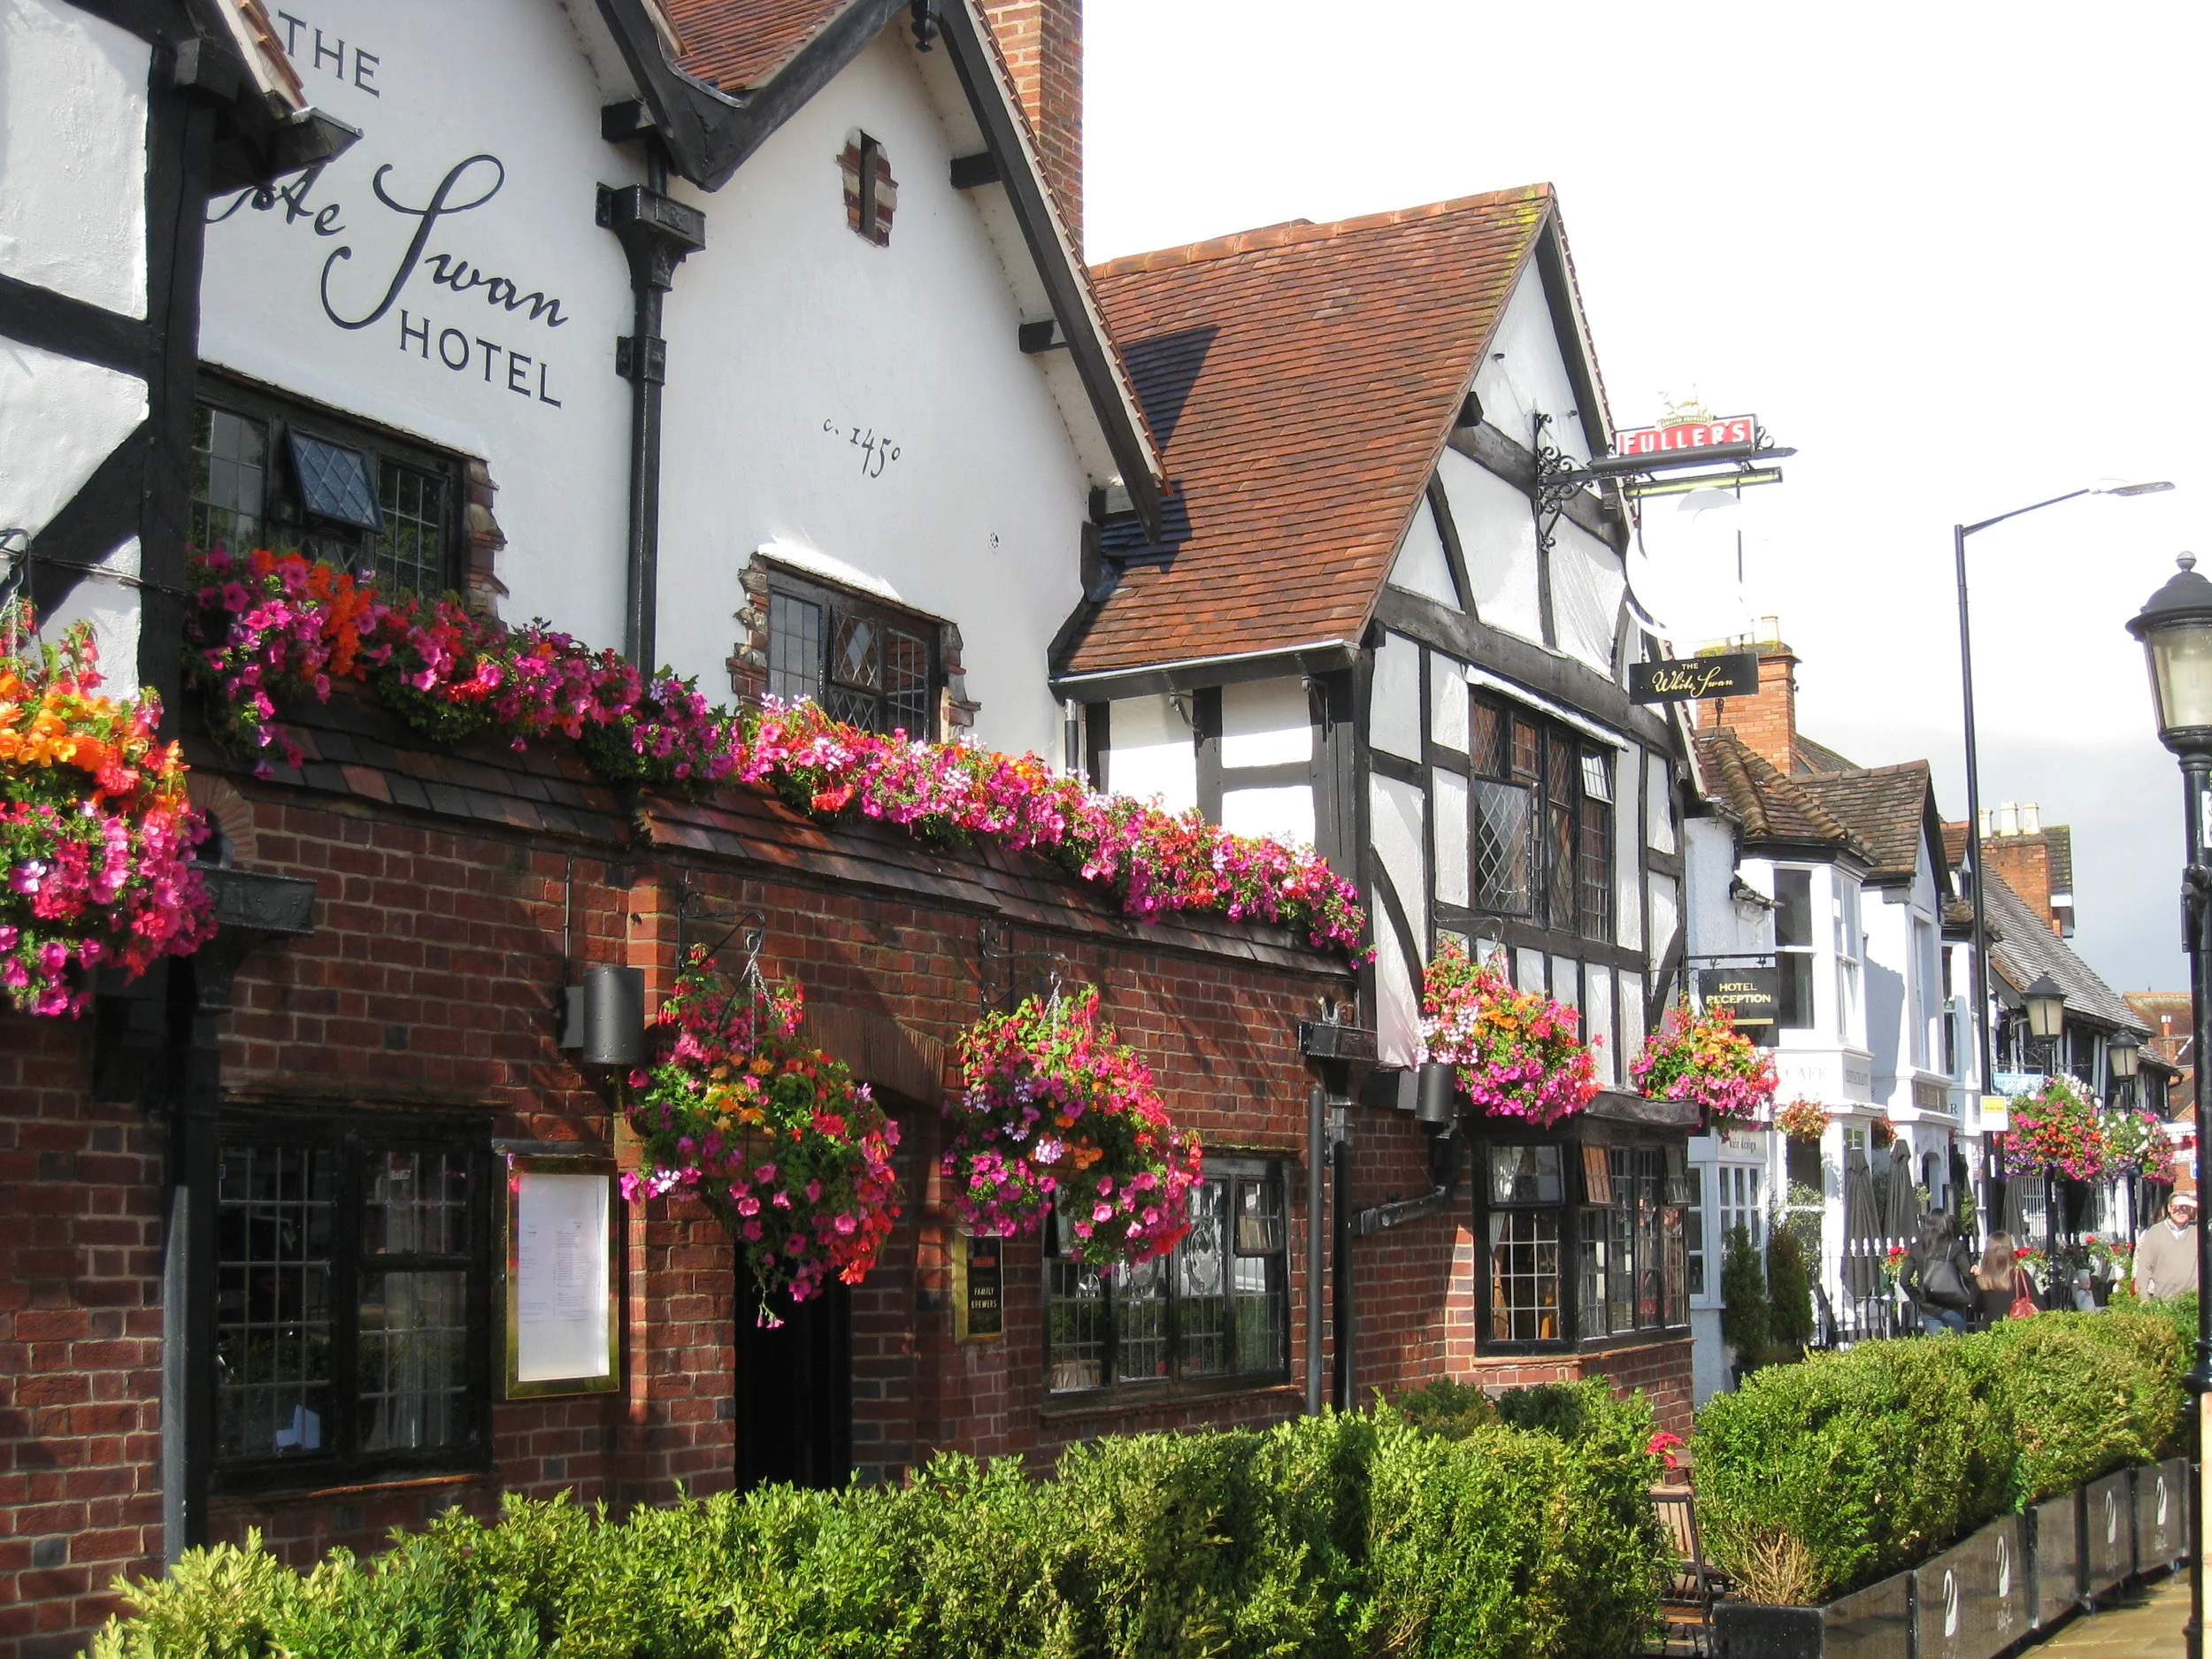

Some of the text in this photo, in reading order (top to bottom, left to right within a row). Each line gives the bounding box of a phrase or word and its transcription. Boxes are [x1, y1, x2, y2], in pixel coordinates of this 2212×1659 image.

[278, 10, 380, 99] THE
[321, 154, 569, 330] Swan
[399, 309, 562, 410] HOTEL
[823, 419, 901, 479] c. 1450
[1652, 666, 1733, 698] White Swan
[1706, 994, 1771, 1004] RECEPTION
[1718, 983, 1757, 992] HOTEL
[971, 1300, 997, 1310] BREWERS
